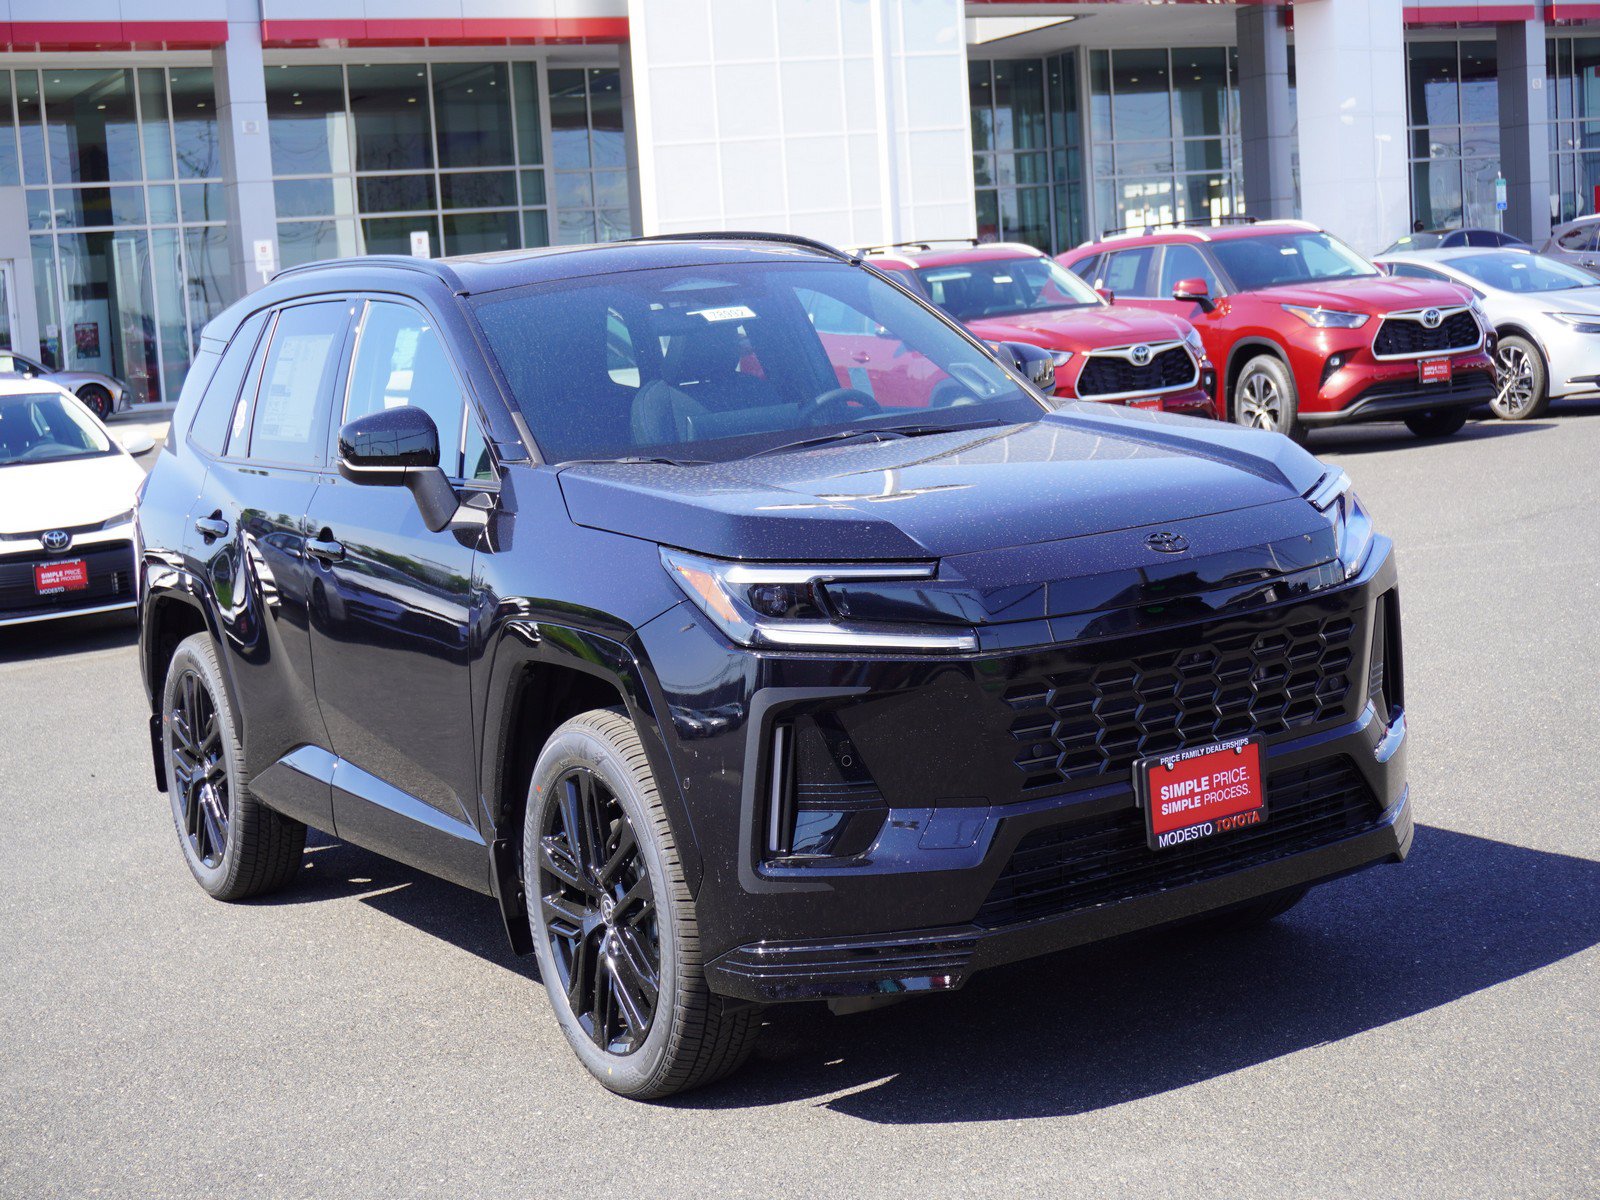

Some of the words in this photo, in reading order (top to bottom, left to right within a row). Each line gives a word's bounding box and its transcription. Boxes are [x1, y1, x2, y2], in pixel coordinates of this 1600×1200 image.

[40, 586, 65, 595] MODESTO
[41, 571, 63, 580] SIMPLE
[1160, 753, 1180, 765] PRICE
[1181, 748, 1205, 760] FAMILY
[1205, 737, 1249, 755] DEALERSHIPS
[1160, 776, 1210, 800] SIMPLE
[1212, 766, 1250, 788] PRICE.
[1161, 796, 1202, 816] SIMPLE
[1203, 783, 1251, 805] PROCESS.
[1158, 822, 1213, 848] MODESTO
[1215, 811, 1260, 832] TOYOTA
